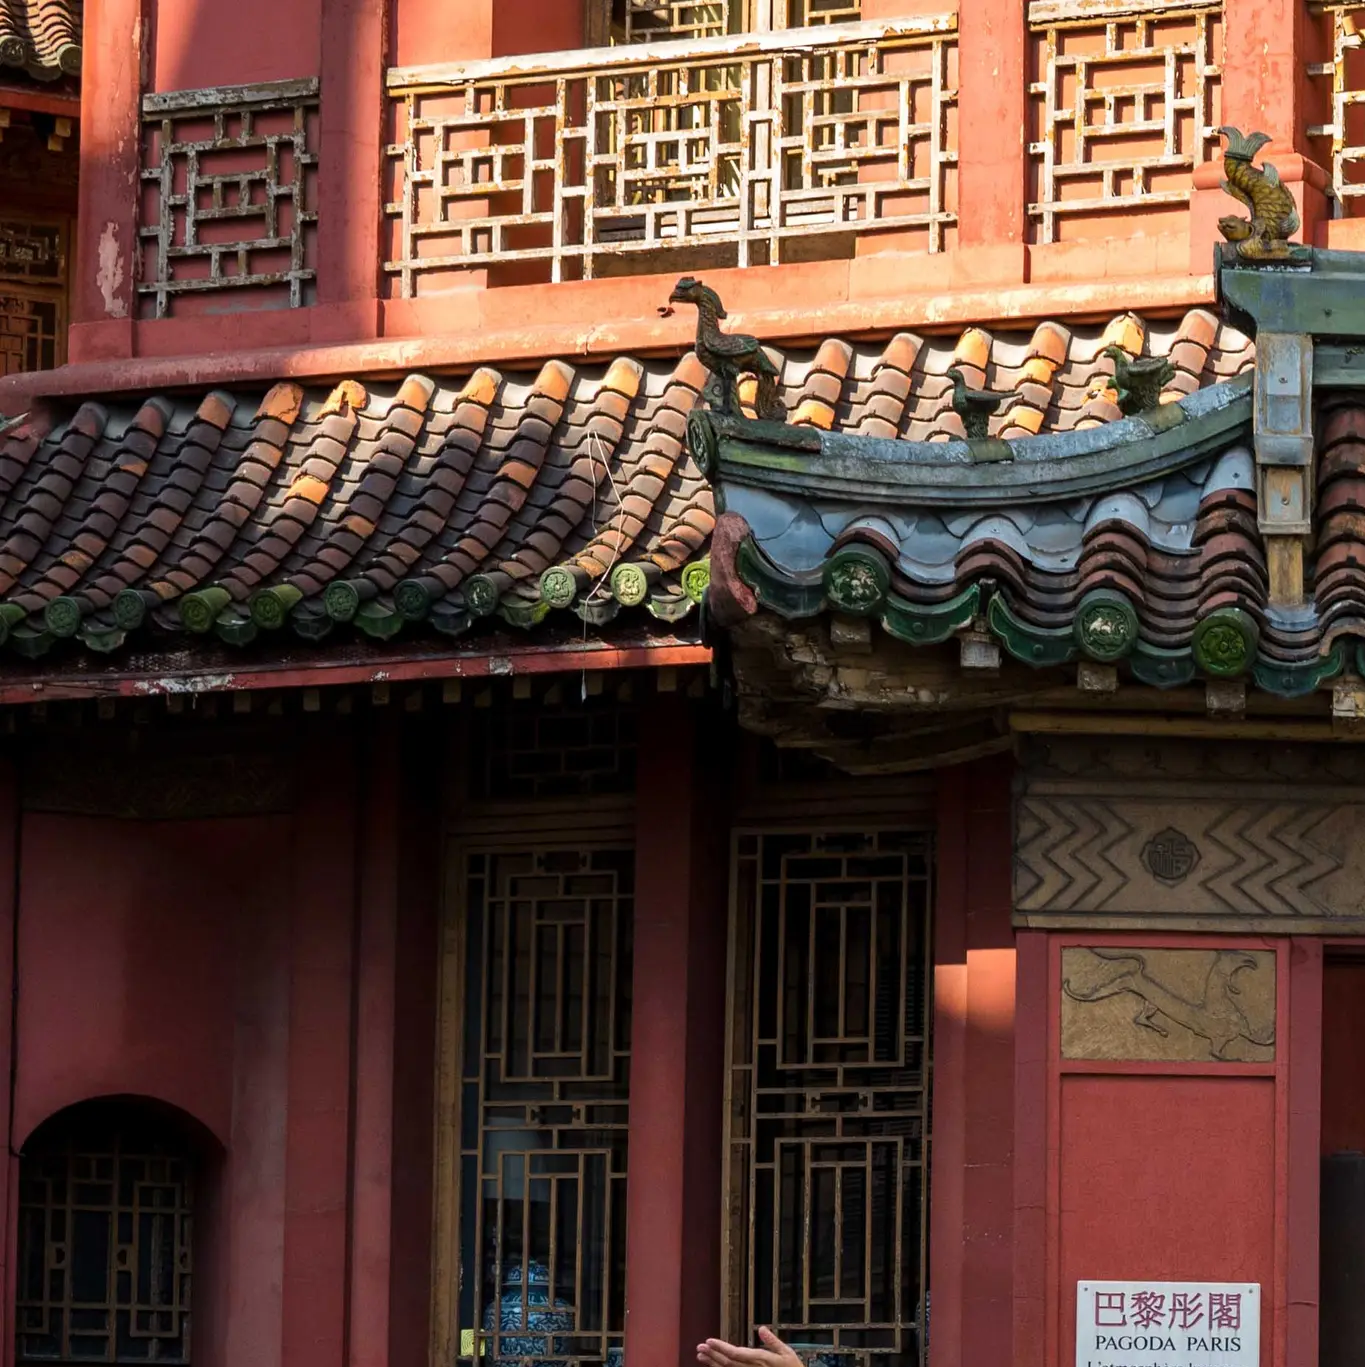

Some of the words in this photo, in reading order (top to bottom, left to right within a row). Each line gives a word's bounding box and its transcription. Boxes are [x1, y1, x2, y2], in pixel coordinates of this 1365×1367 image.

[1094, 1290, 1242, 1331] 巴黎彤閣
[1095, 1335, 1176, 1351] PAGODA
[1187, 1337, 1241, 1352] PARIS
